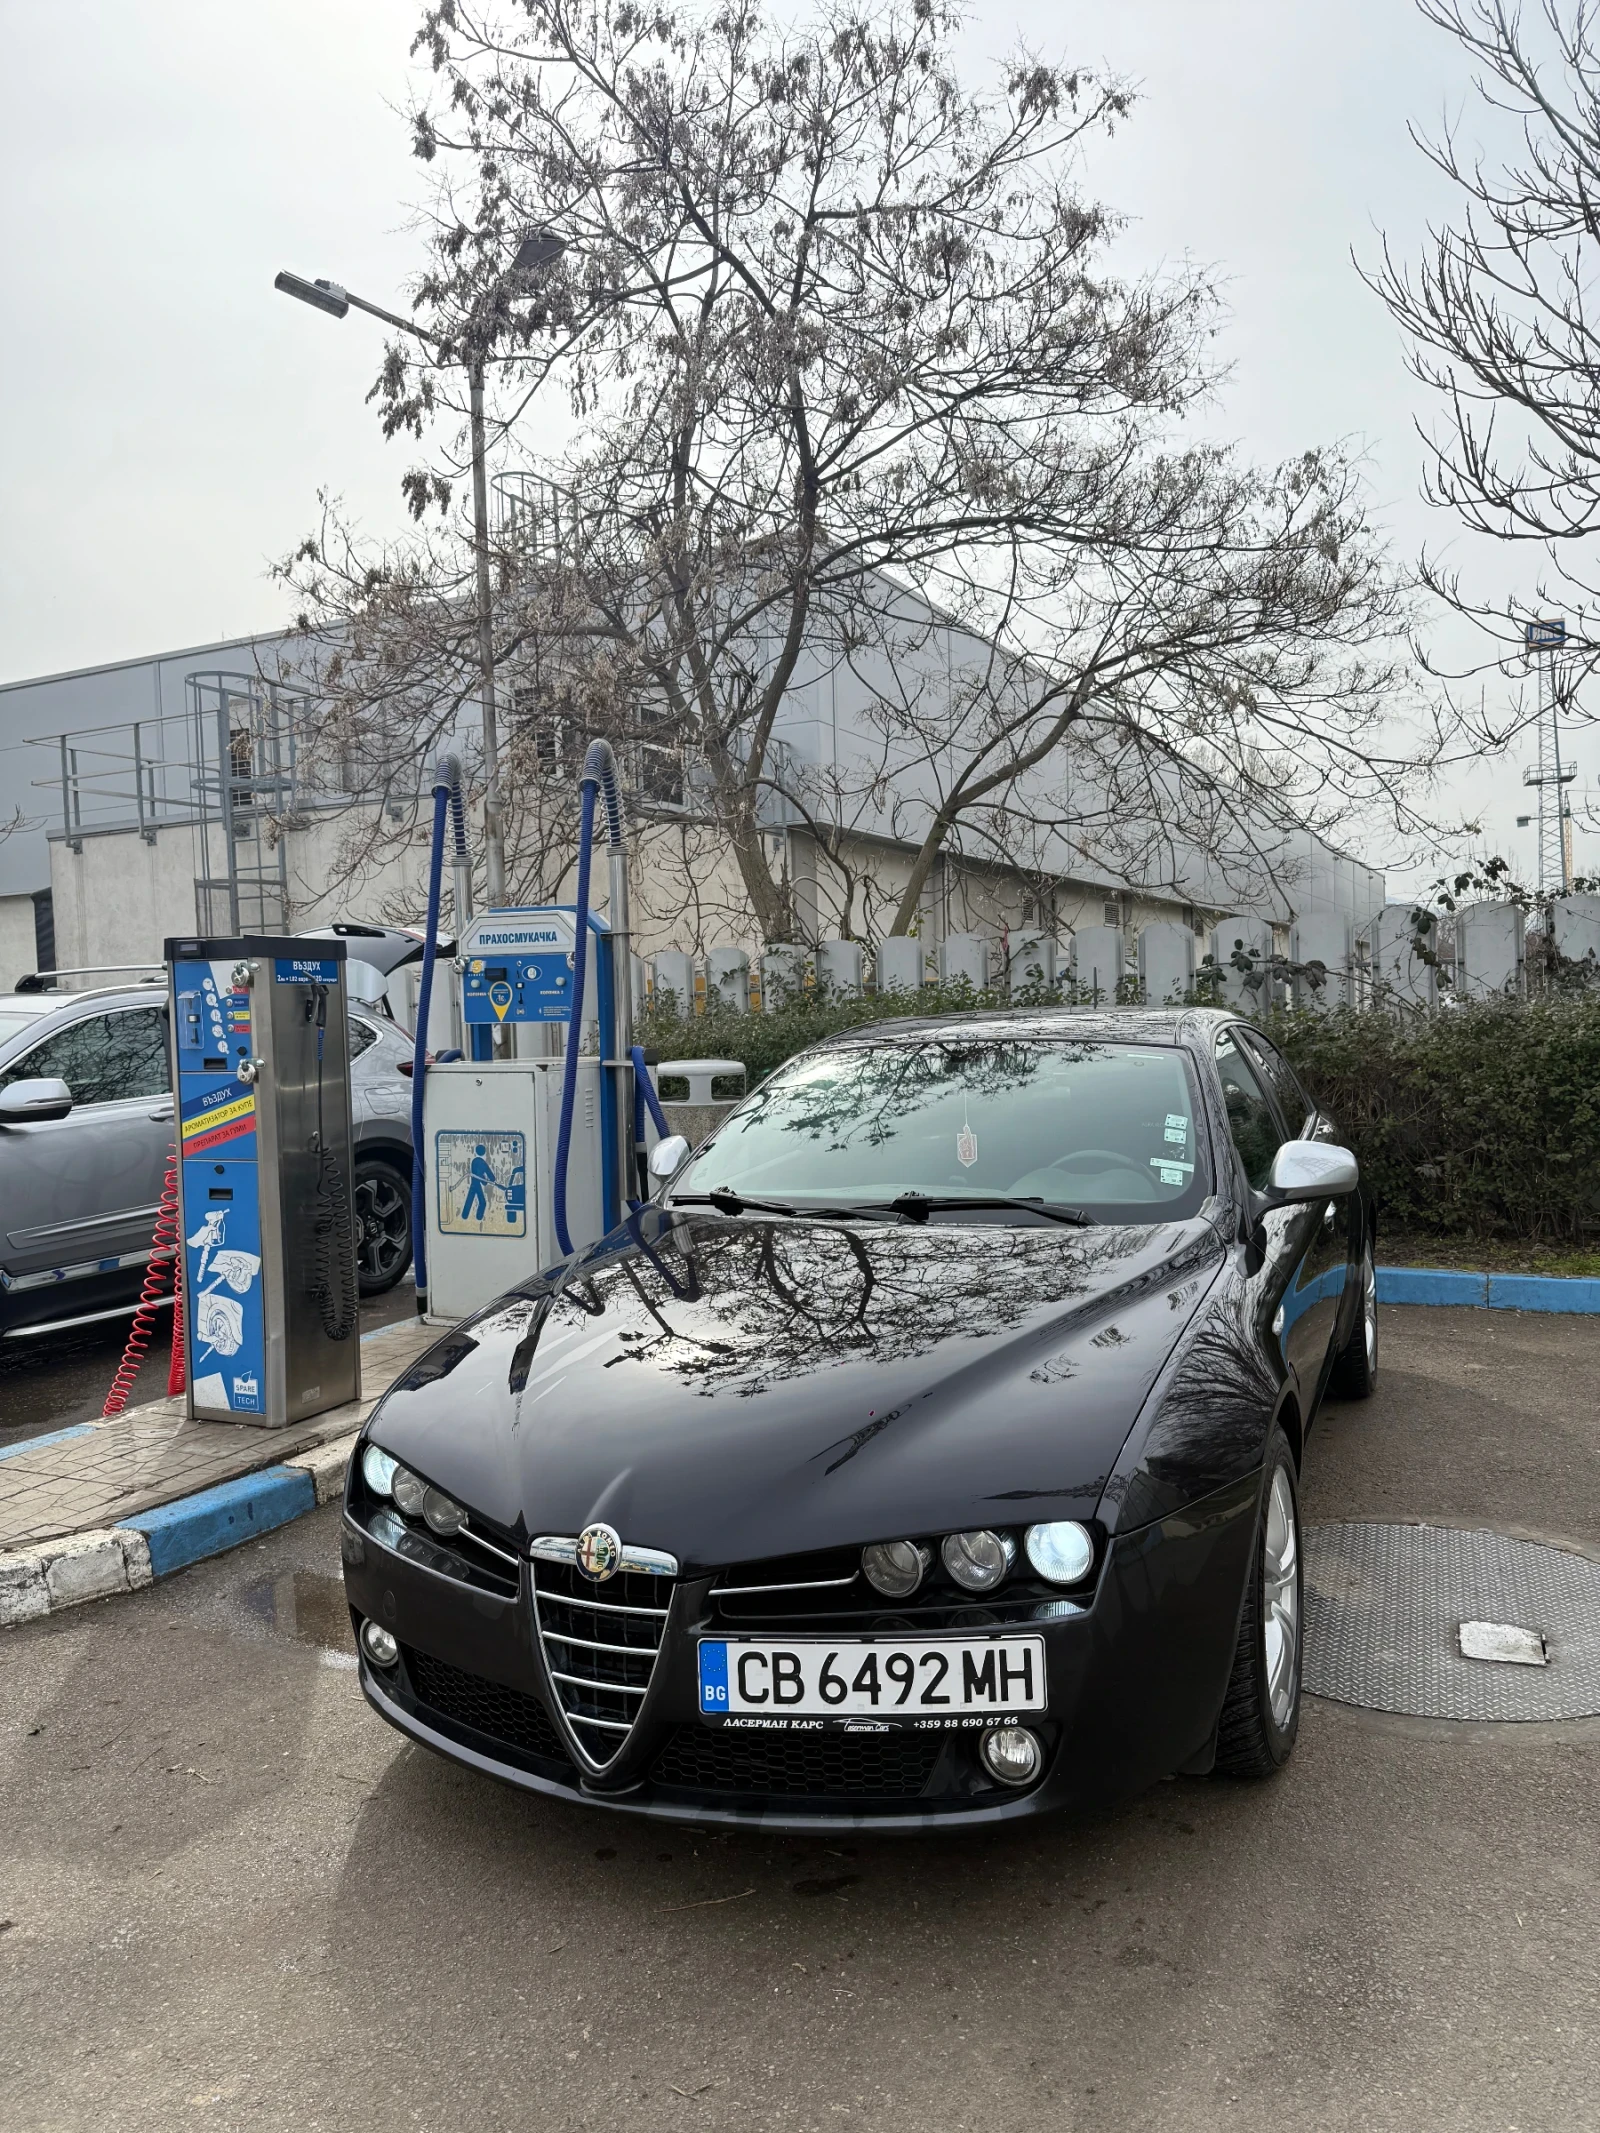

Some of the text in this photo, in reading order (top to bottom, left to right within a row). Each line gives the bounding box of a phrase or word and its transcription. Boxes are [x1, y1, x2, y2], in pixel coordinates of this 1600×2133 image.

[479, 931, 557, 944] ПРАХОСМУКАЧКА
[293, 961, 321, 972] ВЪЗДУХ
[472, 960, 483, 973] 5
[202, 1088, 232, 1107] ВЪЗДУХ
[185, 1100, 253, 1133] АРОМАТИЗАТОР ЗА КУПЕ
[193, 1124, 247, 1148] ПРЕПАРАТ ЗА ГУМИ
[235, 1384, 256, 1393] SPARE
[237, 1396, 255, 1405] TECH
[597, 1530, 616, 1557] ROMEO
[737, 1648, 1034, 1705] CB 6492 MH
[705, 1685, 726, 1701] BG
[723, 1718, 824, 1729] ЛАСЕРМАН КАРС
[913, 1716, 1018, 1729] +359 88 690 67 66
